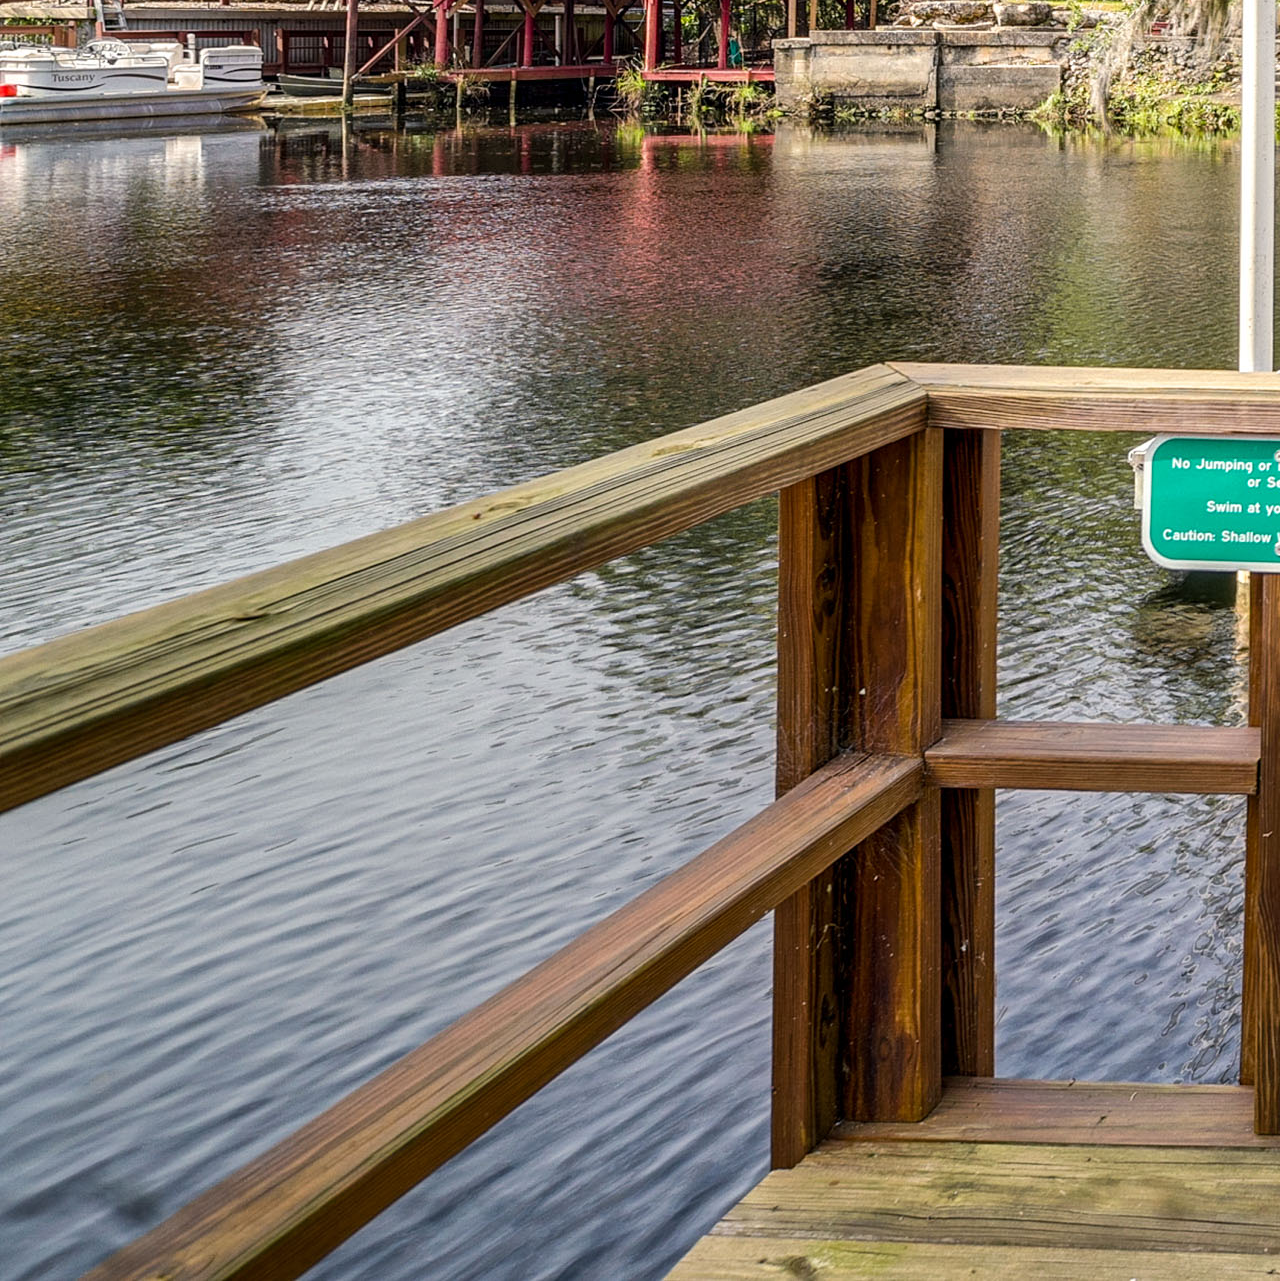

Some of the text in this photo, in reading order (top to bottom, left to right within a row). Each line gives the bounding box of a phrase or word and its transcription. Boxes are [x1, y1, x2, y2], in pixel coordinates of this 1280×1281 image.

[52, 74, 95, 84] Tuscany
[1172, 458, 1190, 469] No
[1196, 459, 1253, 473] Jumping
[1258, 462, 1272, 471] or
[1248, 479, 1261, 487] or
[1207, 500, 1242, 512] Swim
[1248, 503, 1260, 513] at
[1163, 529, 1215, 541] Caution:
[1222, 530, 1271, 542] Shallow
